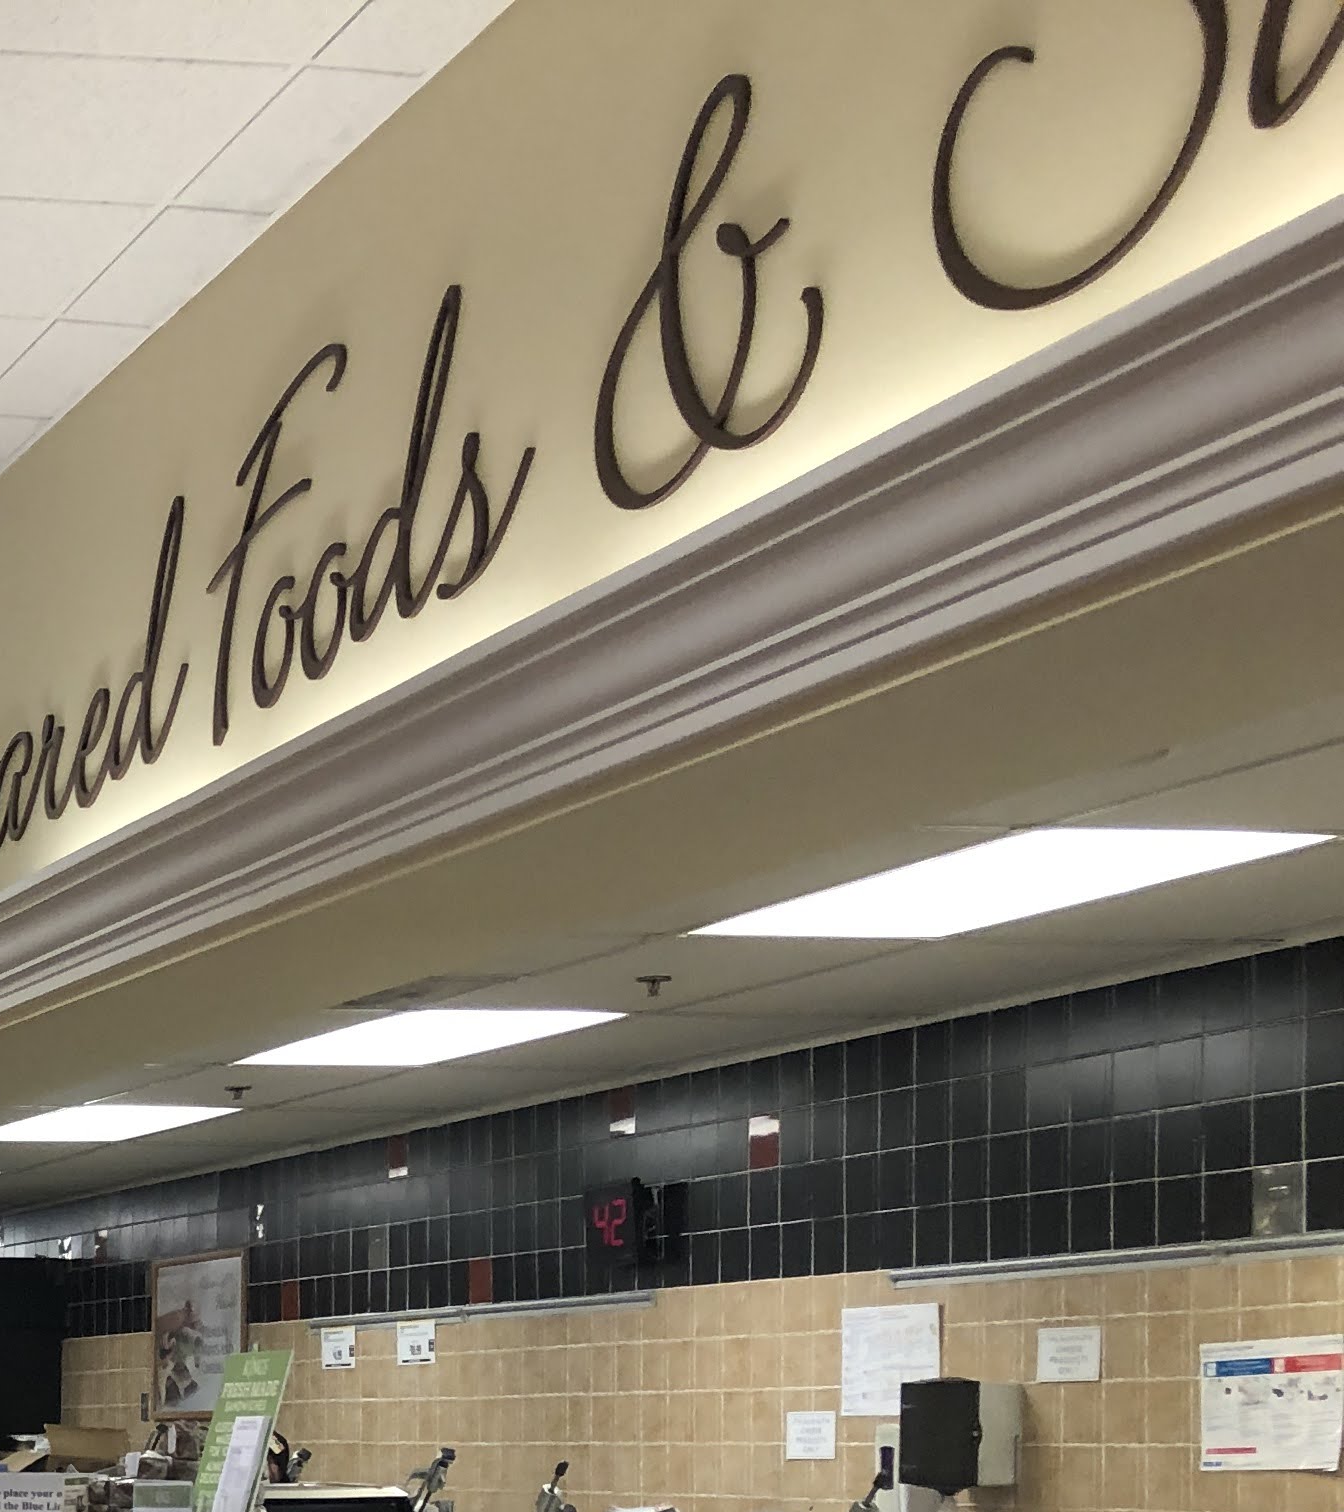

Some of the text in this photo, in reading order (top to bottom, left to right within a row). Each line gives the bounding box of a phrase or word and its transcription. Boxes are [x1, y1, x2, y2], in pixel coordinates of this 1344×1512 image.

[206, 284, 536, 747] Foods
[595, 72, 826, 510] &
[593, 1197, 627, 1247] 42
[3, 1488, 29, 1500] place
[30, 1490, 54, 1500] your
[3, 1502, 19, 1510] the
[22, 1501, 44, 1511] Blue
